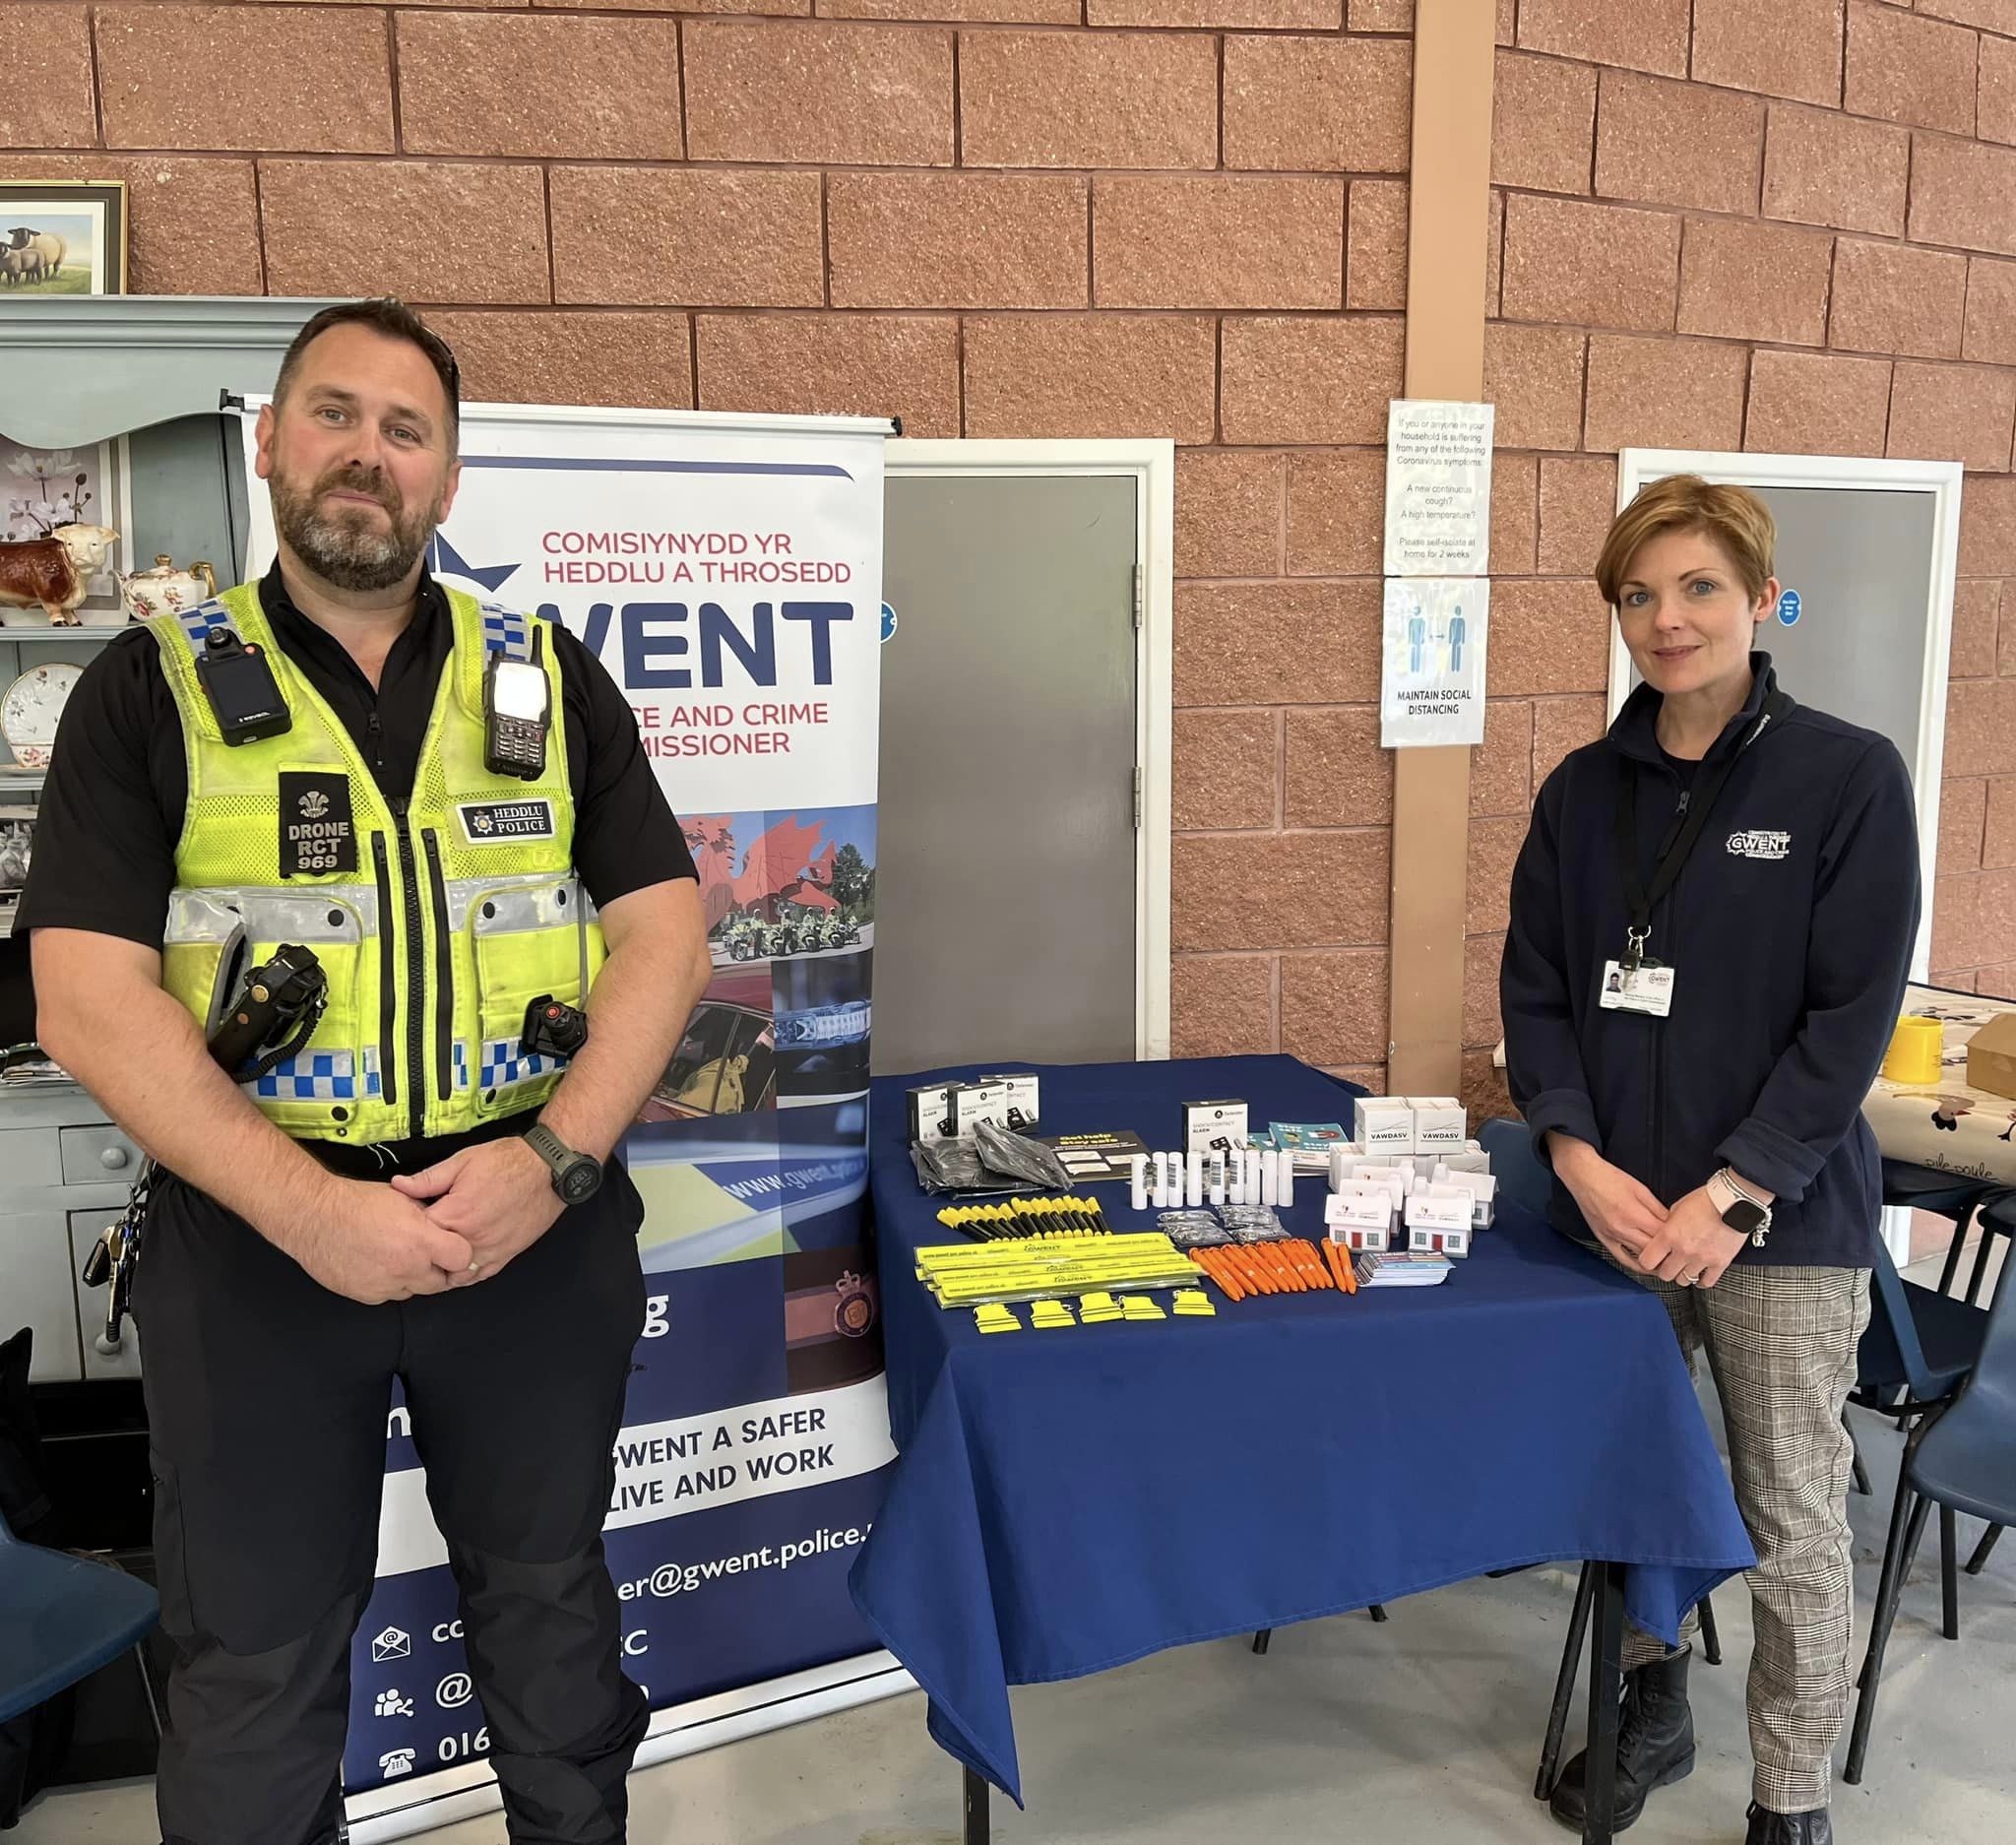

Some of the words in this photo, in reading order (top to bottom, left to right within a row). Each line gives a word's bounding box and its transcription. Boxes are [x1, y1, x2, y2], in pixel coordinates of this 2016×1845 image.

[1401, 432, 1439, 441] household
[1449, 432, 1481, 444] suffering
[1396, 443, 1414, 453] from
[1415, 445, 1429, 454] any
[1453, 444, 1485, 456] following
[1396, 456, 1442, 466] Coronavirus
[1424, 496, 1453, 507] cough?
[1408, 510, 1424, 520] high
[542, 531, 748, 555] COMISIYNYDD
[754, 533, 792, 555] YR
[1446, 549, 1470, 559] weeks
[543, 560, 665, 584] HEDDLU
[672, 561, 694, 584] A
[699, 561, 851, 585] THROSEDD
[1397, 690, 1439, 701] MAINTAIN
[1440, 689, 1472, 700] SOCIAL
[669, 704, 734, 729] AND
[742, 702, 829, 727] CRIME
[1408, 704, 1459, 716] DISTANCING
[493, 805, 543, 819] HEDDLU
[288, 821, 349, 841] DRONE
[496, 820, 546, 834] POLICE
[297, 838, 342, 857] RCT
[1731, 836, 1791, 853] GWENT
[297, 854, 338, 869] 969
[611, 1431, 703, 1469] WENT
[711, 1426, 733, 1451] A
[741, 1408, 827, 1444] SAFER
[673, 1464, 737, 1500] AND
[745, 1443, 835, 1483] WORK
[617, 1523, 873, 1602] er@gwent.police.
